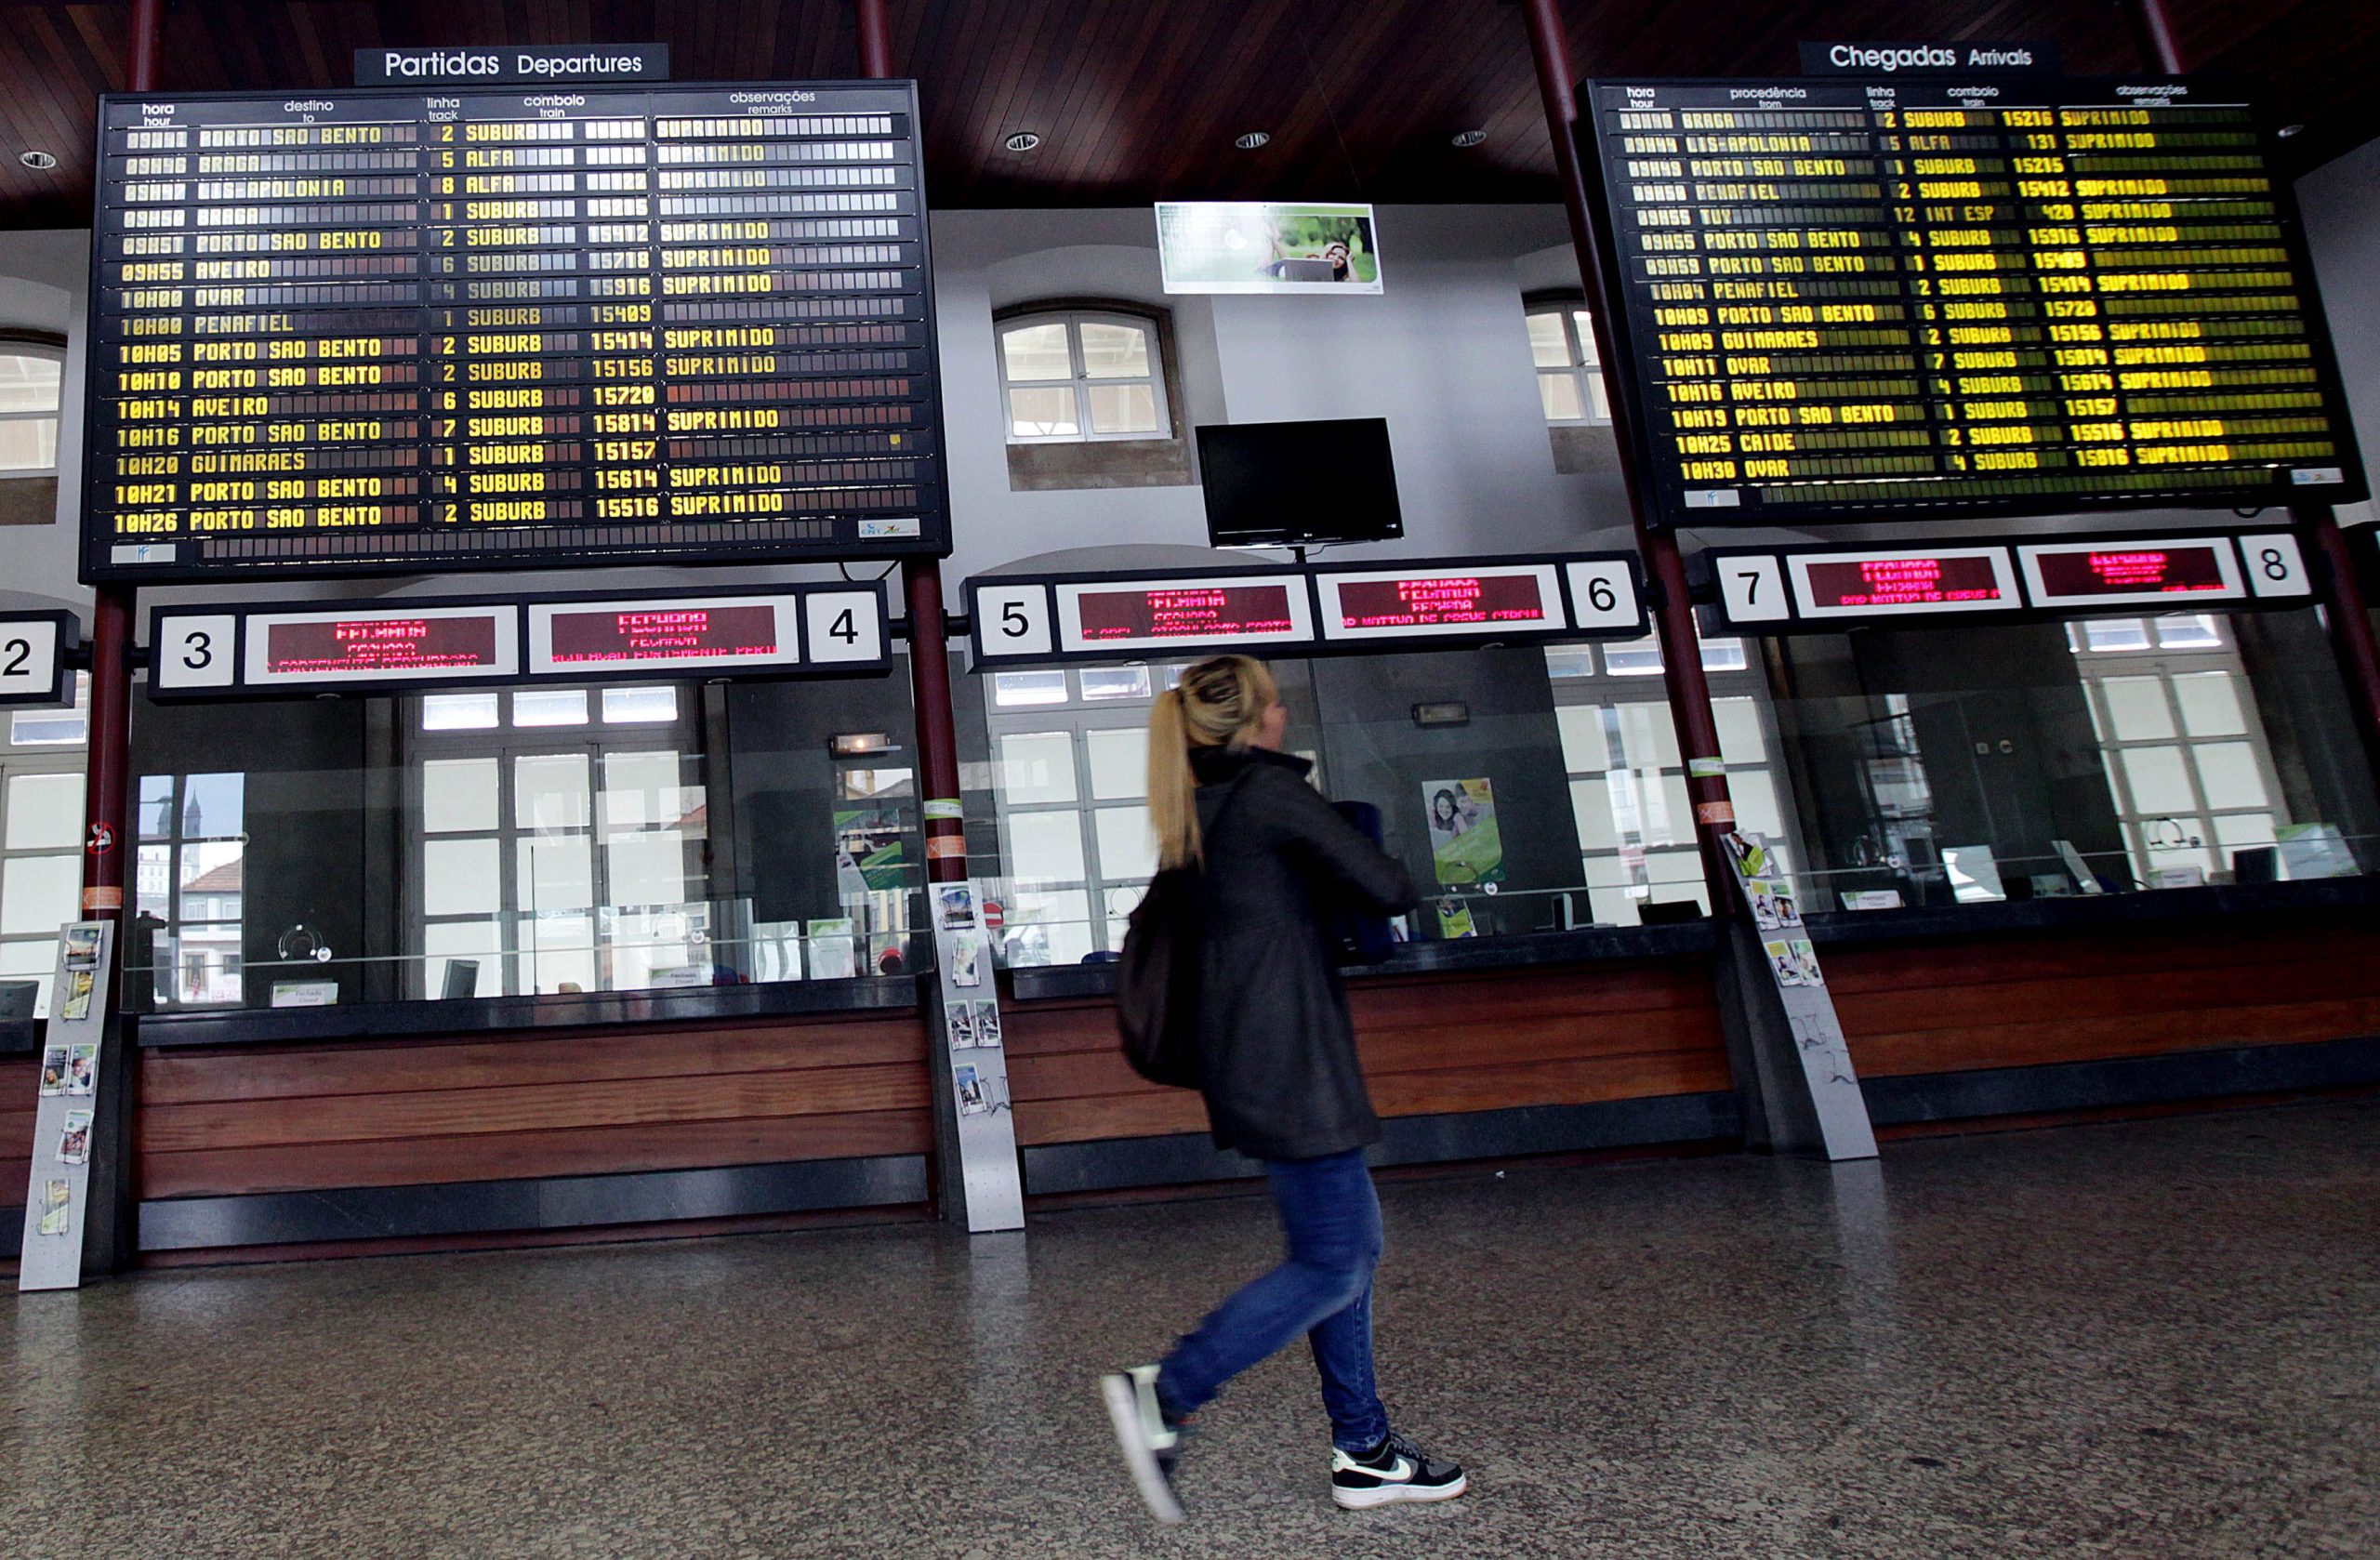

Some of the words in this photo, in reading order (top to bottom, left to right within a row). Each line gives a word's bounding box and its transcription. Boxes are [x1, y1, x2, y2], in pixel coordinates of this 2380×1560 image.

[385, 51, 500, 76] Partidas
[517, 53, 642, 77] Departures
[1830, 46, 1956, 72] Chegadas
[1968, 48, 2032, 66] Arrivals
[142, 103, 175, 115] hora
[284, 100, 334, 112] destino
[427, 97, 460, 108] linha
[730, 90, 815, 104] observações
[1627, 86, 1655, 98] hora
[1730, 86, 1807, 100] procedência
[1866, 86, 1896, 98] linha
[1631, 99, 1654, 108] hour
[1759, 99, 1783, 109] from
[1870, 99, 1896, 108] track
[143, 116, 171, 126] hour
[303, 113, 315, 124] to
[429, 111, 458, 121] track
[539, 108, 565, 118] train
[747, 104, 793, 114] remarks
[1904, 112, 1964, 127] SUBURB
[2003, 112, 2052, 126] 15216
[271, 128, 308, 146] SAO
[320, 127, 379, 145] BENTO
[466, 124, 536, 142] SUBURB
[1685, 137, 1810, 152] LIS-APOLONIA
[1911, 137, 1947, 149] ALFA
[2029, 135, 2060, 149] 131
[466, 151, 513, 167] ALFA
[1689, 161, 1743, 177] PORTO
[1752, 161, 1784, 177] SAO
[1792, 160, 1845, 176] BENTO
[1915, 159, 1975, 174] SUBURB
[2015, 158, 2063, 173] 15215
[466, 177, 514, 194] ALFA
[1694, 185, 1778, 201] PENAFIEL
[1920, 182, 1980, 198] SUBURB
[2018, 181, 2069, 196] 15412
[467, 202, 538, 220] SUBURB
[1922, 207, 1951, 219] INT
[1965, 206, 1992, 220] ESP
[2043, 205, 2073, 219] 420
[270, 233, 307, 251] SAO
[319, 231, 379, 250] BENTO
[661, 223, 768, 242] SUPRIMIDO
[1702, 234, 1757, 247] PORTO
[1767, 232, 1798, 247] SAO
[1808, 232, 1859, 247] BENTO
[1930, 231, 1990, 245] SUBURB
[2030, 229, 2080, 244] 15916
[122, 263, 183, 282] 09H55
[195, 261, 270, 280] AVEIRO
[662, 249, 770, 269] SUPRIMIDO
[1711, 258, 1762, 272] PORTO
[1772, 258, 1803, 271] SAO
[1814, 257, 1864, 271] BENTO
[1934, 254, 1996, 271] SUBURB
[121, 290, 183, 309] 10H00
[195, 289, 245, 307] OVAR
[663, 275, 771, 293] SUPRIMIDO
[1714, 283, 1798, 297] PENAFIEL
[1939, 278, 2001, 295] SUBURB
[120, 317, 180, 334] 10H00
[194, 318, 291, 335] PENAFIEL
[468, 309, 540, 327] SUBURB
[591, 306, 651, 322] 15409
[1655, 309, 1708, 324] 10H09
[1718, 308, 1771, 324] PORTO
[1781, 307, 1813, 323] SAO
[1822, 305, 1874, 322] BENTO
[1945, 303, 2005, 319] SUBURB
[122, 345, 181, 363] 10H05
[194, 343, 256, 360] PORTO
[270, 341, 305, 359] SAO
[319, 339, 380, 357] BENTO
[469, 336, 541, 353] SUBURB
[594, 333, 652, 350] 15414
[665, 329, 774, 348] SUPRIMIDO
[1660, 334, 1712, 350] 10H09
[1722, 331, 1818, 349] GUIMARAES
[1950, 328, 2011, 343] SUBURB
[121, 372, 180, 390] 10H10
[193, 370, 256, 388] PORTO
[269, 368, 306, 386] SAO
[319, 366, 380, 385] BENTO
[469, 363, 541, 380] SUBURB
[595, 360, 653, 377] 15156
[667, 358, 774, 375] SUPRIMIDO
[1664, 359, 1714, 376] 10H11
[1726, 357, 1770, 375] OVAR
[1954, 352, 2016, 368] SUBURB
[1668, 384, 1722, 401] 10H16
[1731, 382, 1795, 399] AVEIRO
[1960, 377, 2021, 393] SUBURB
[119, 401, 179, 418] 10H14
[192, 398, 268, 416] AVEIRO
[469, 390, 542, 408] SUBURB
[595, 387, 654, 404] 15720
[1673, 410, 1726, 427] 10H19
[1736, 408, 1790, 425] PORTO
[1799, 407, 1831, 424] SAO
[1841, 405, 1894, 423] BENTO
[1964, 402, 2027, 418] SUBURB
[119, 429, 178, 446] 10H16
[192, 427, 254, 443] PORTO
[269, 425, 305, 442] SAO
[319, 422, 380, 440] BENTO
[469, 416, 543, 436] SUBURB
[595, 415, 654, 432] 15814
[668, 410, 778, 430] SUPRIMIDO
[1676, 436, 1730, 453] 10H25
[1740, 434, 1794, 451] CAIDE
[1969, 427, 2032, 444] SUBURB
[120, 457, 178, 474] 10H20
[192, 453, 304, 472] GUIMARAES
[469, 445, 543, 464] SUBURB
[595, 442, 654, 460] 15157
[1682, 462, 1735, 479] 10H30
[1745, 460, 1789, 477] OVAR
[1975, 453, 2037, 469] SUBURB
[116, 484, 175, 503] 10H21
[192, 483, 254, 501] PORTO
[268, 481, 304, 498] SAO
[318, 478, 380, 497] BENTO
[469, 473, 544, 493] SUBURB
[596, 469, 656, 488] 15614
[670, 466, 781, 486] SUPRIMIDO
[116, 513, 177, 532] 10H26
[191, 510, 253, 530] PORTO
[268, 509, 304, 528] SAO
[318, 507, 380, 526] BENTO
[470, 502, 545, 521] SUBURB
[599, 497, 658, 517] 15516
[671, 494, 782, 515] SUPRIMIDO
[2260, 548, 2288, 581] 8
[1588, 576, 1617, 612] 6
[1737, 572, 1761, 605] 7
[829, 608, 859, 644] 4
[1001, 602, 1029, 638] 5
[3, 639, 31, 676] 2
[182, 631, 213, 668] 3
